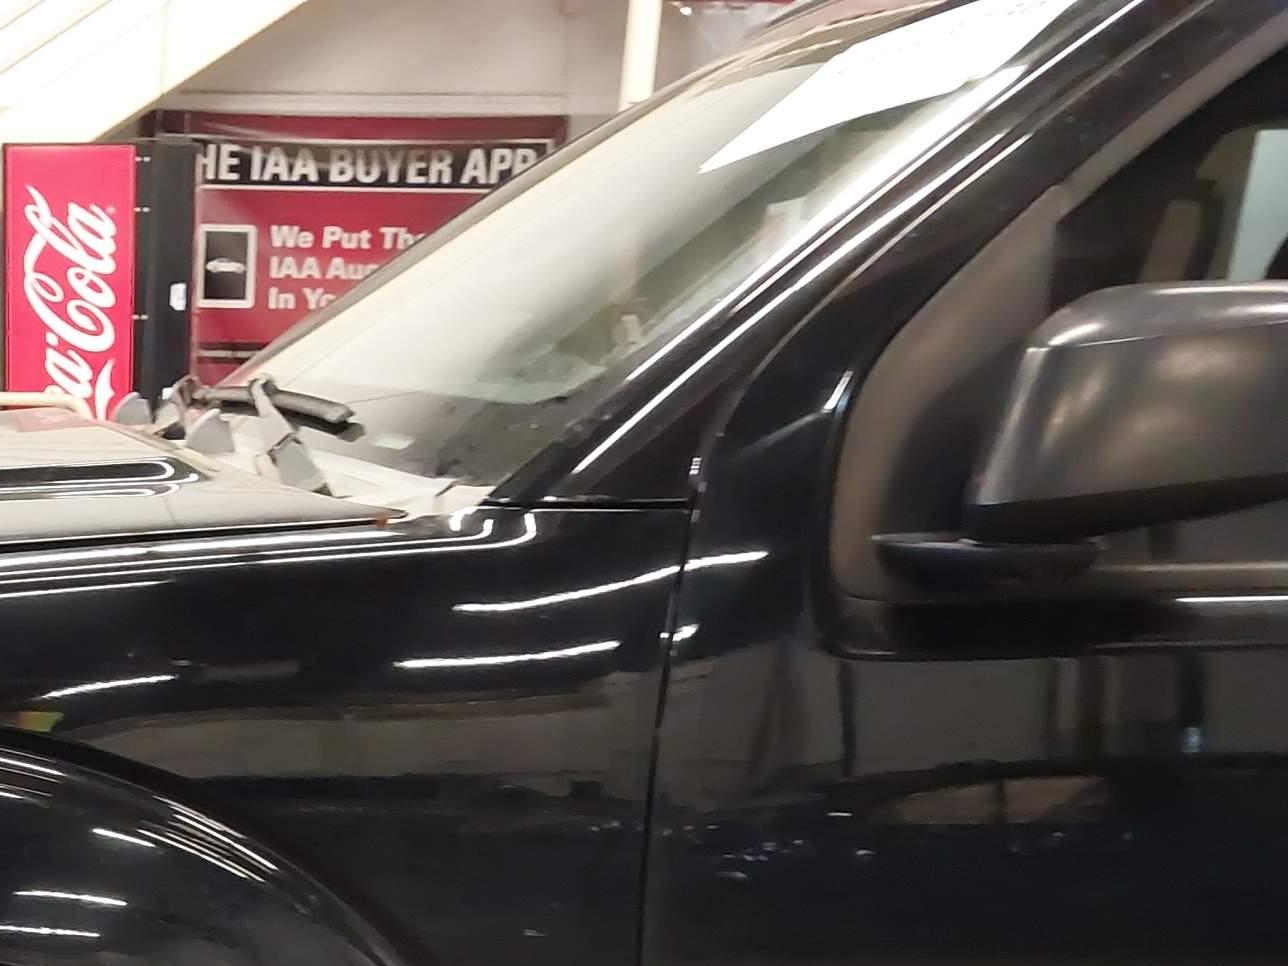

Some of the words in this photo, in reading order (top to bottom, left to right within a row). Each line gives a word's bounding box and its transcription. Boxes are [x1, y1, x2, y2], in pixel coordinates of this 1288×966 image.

[196, 143, 241, 181] HE
[249, 146, 318, 183] IAA
[328, 148, 454, 185] BUYER
[460, 148, 538, 184] APP
[270, 225, 314, 249] We
[322, 226, 371, 250] Put
[378, 227, 426, 251] Th
[269, 257, 321, 280] IAA
[23, 183, 117, 420] a-Cola
[268, 287, 296, 310] In
